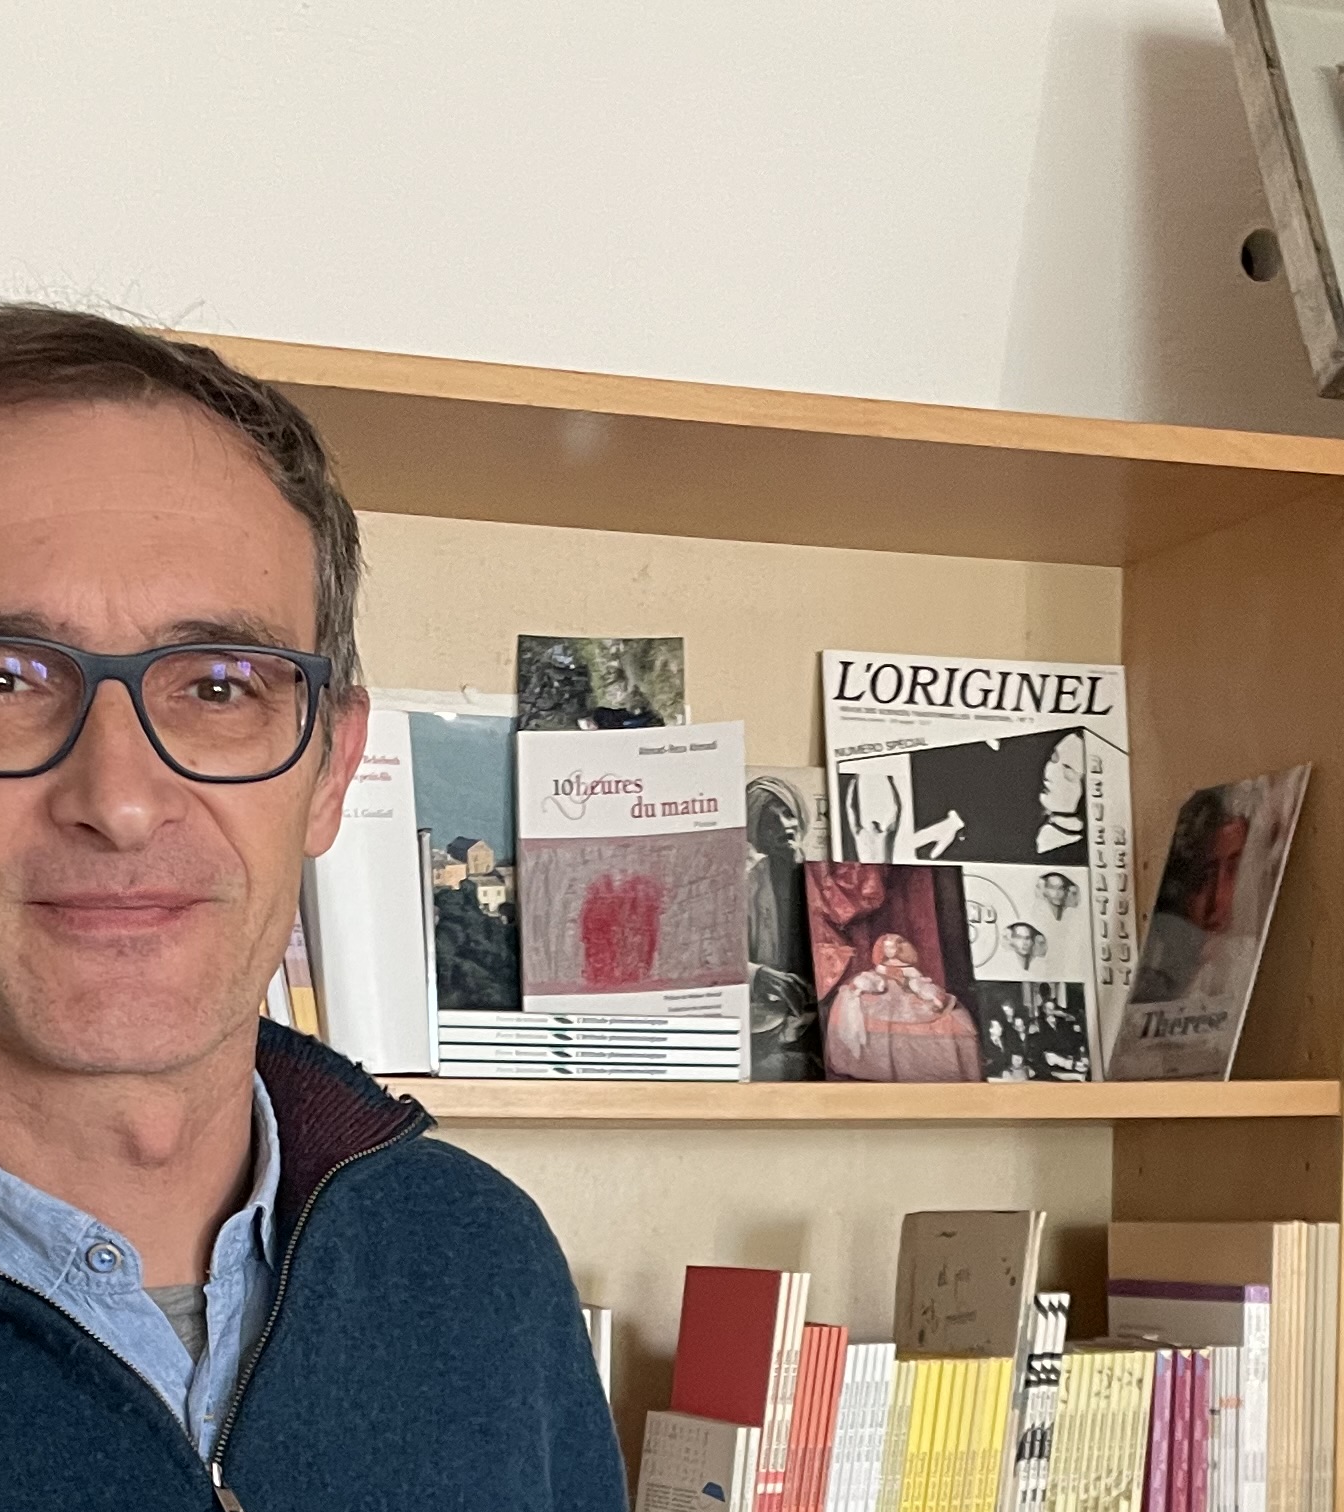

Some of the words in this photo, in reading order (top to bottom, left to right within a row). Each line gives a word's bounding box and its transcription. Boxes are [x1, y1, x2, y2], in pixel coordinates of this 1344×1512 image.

[832, 660, 1114, 716] L'ORIGINEL
[552, 778, 572, 797] 10
[630, 797, 657, 819] du
[661, 792, 719, 818] matin
